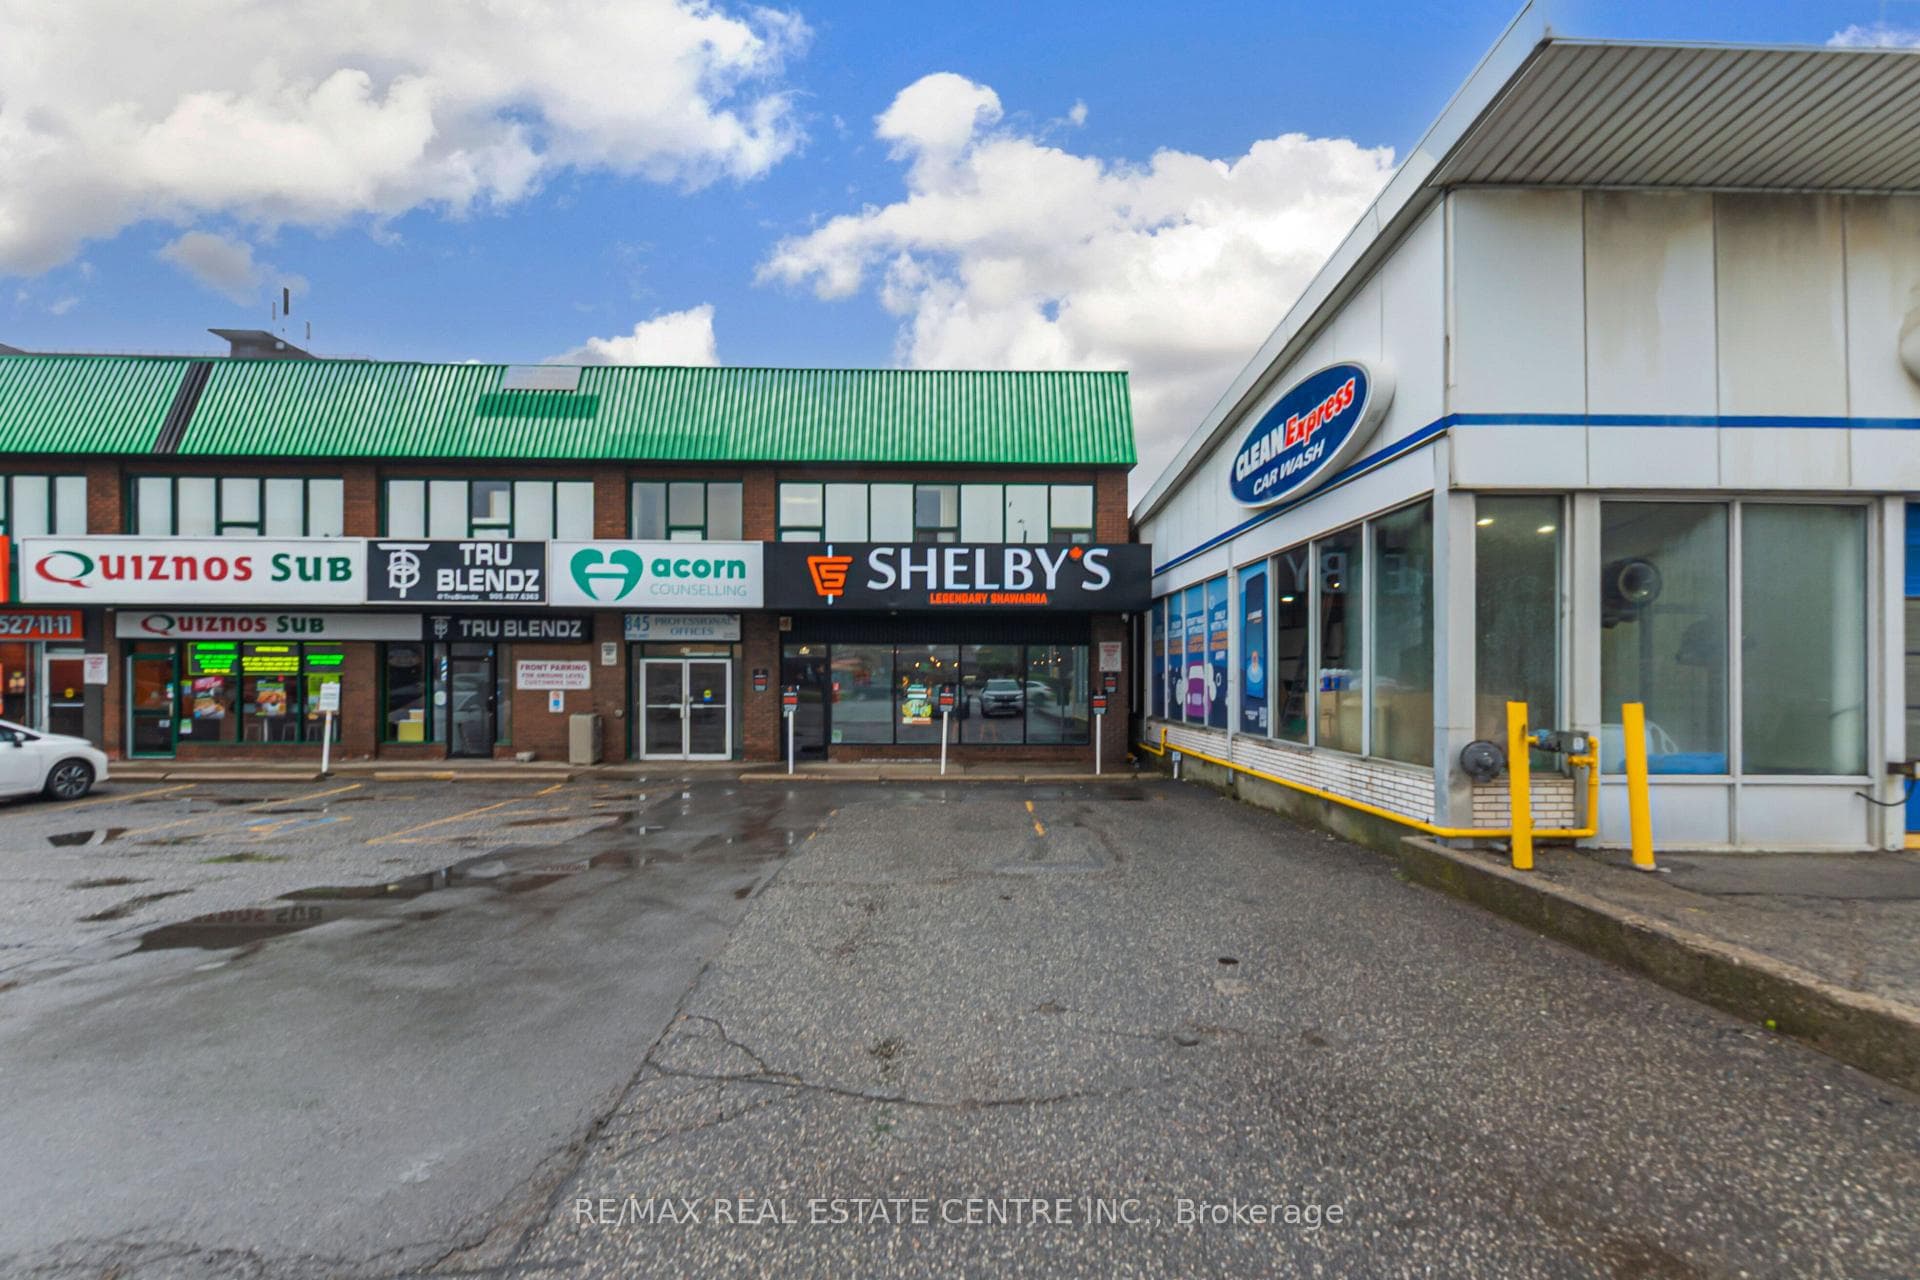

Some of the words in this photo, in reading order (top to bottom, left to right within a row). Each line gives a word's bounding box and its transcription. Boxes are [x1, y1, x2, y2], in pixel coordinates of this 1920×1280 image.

[1235, 422, 1286, 482] CLEAN
[1284, 377, 1356, 448] Express
[1253, 468, 1278, 495] CAR
[1280, 439, 1326, 480] WASH
[458, 543, 513, 566] TRU
[651, 558, 746, 579] acorn
[866, 546, 1111, 591] SHELBY'S
[436, 569, 540, 592] BLENDZ
[649, 583, 748, 597] COUNSELLING
[929, 592, 988, 605] LEGENDARY
[990, 592, 1048, 605] SHAWARMA
[459, 619, 499, 637] TRU
[503, 620, 582, 638] BLENDZ
[624, 615, 650, 632] 845
